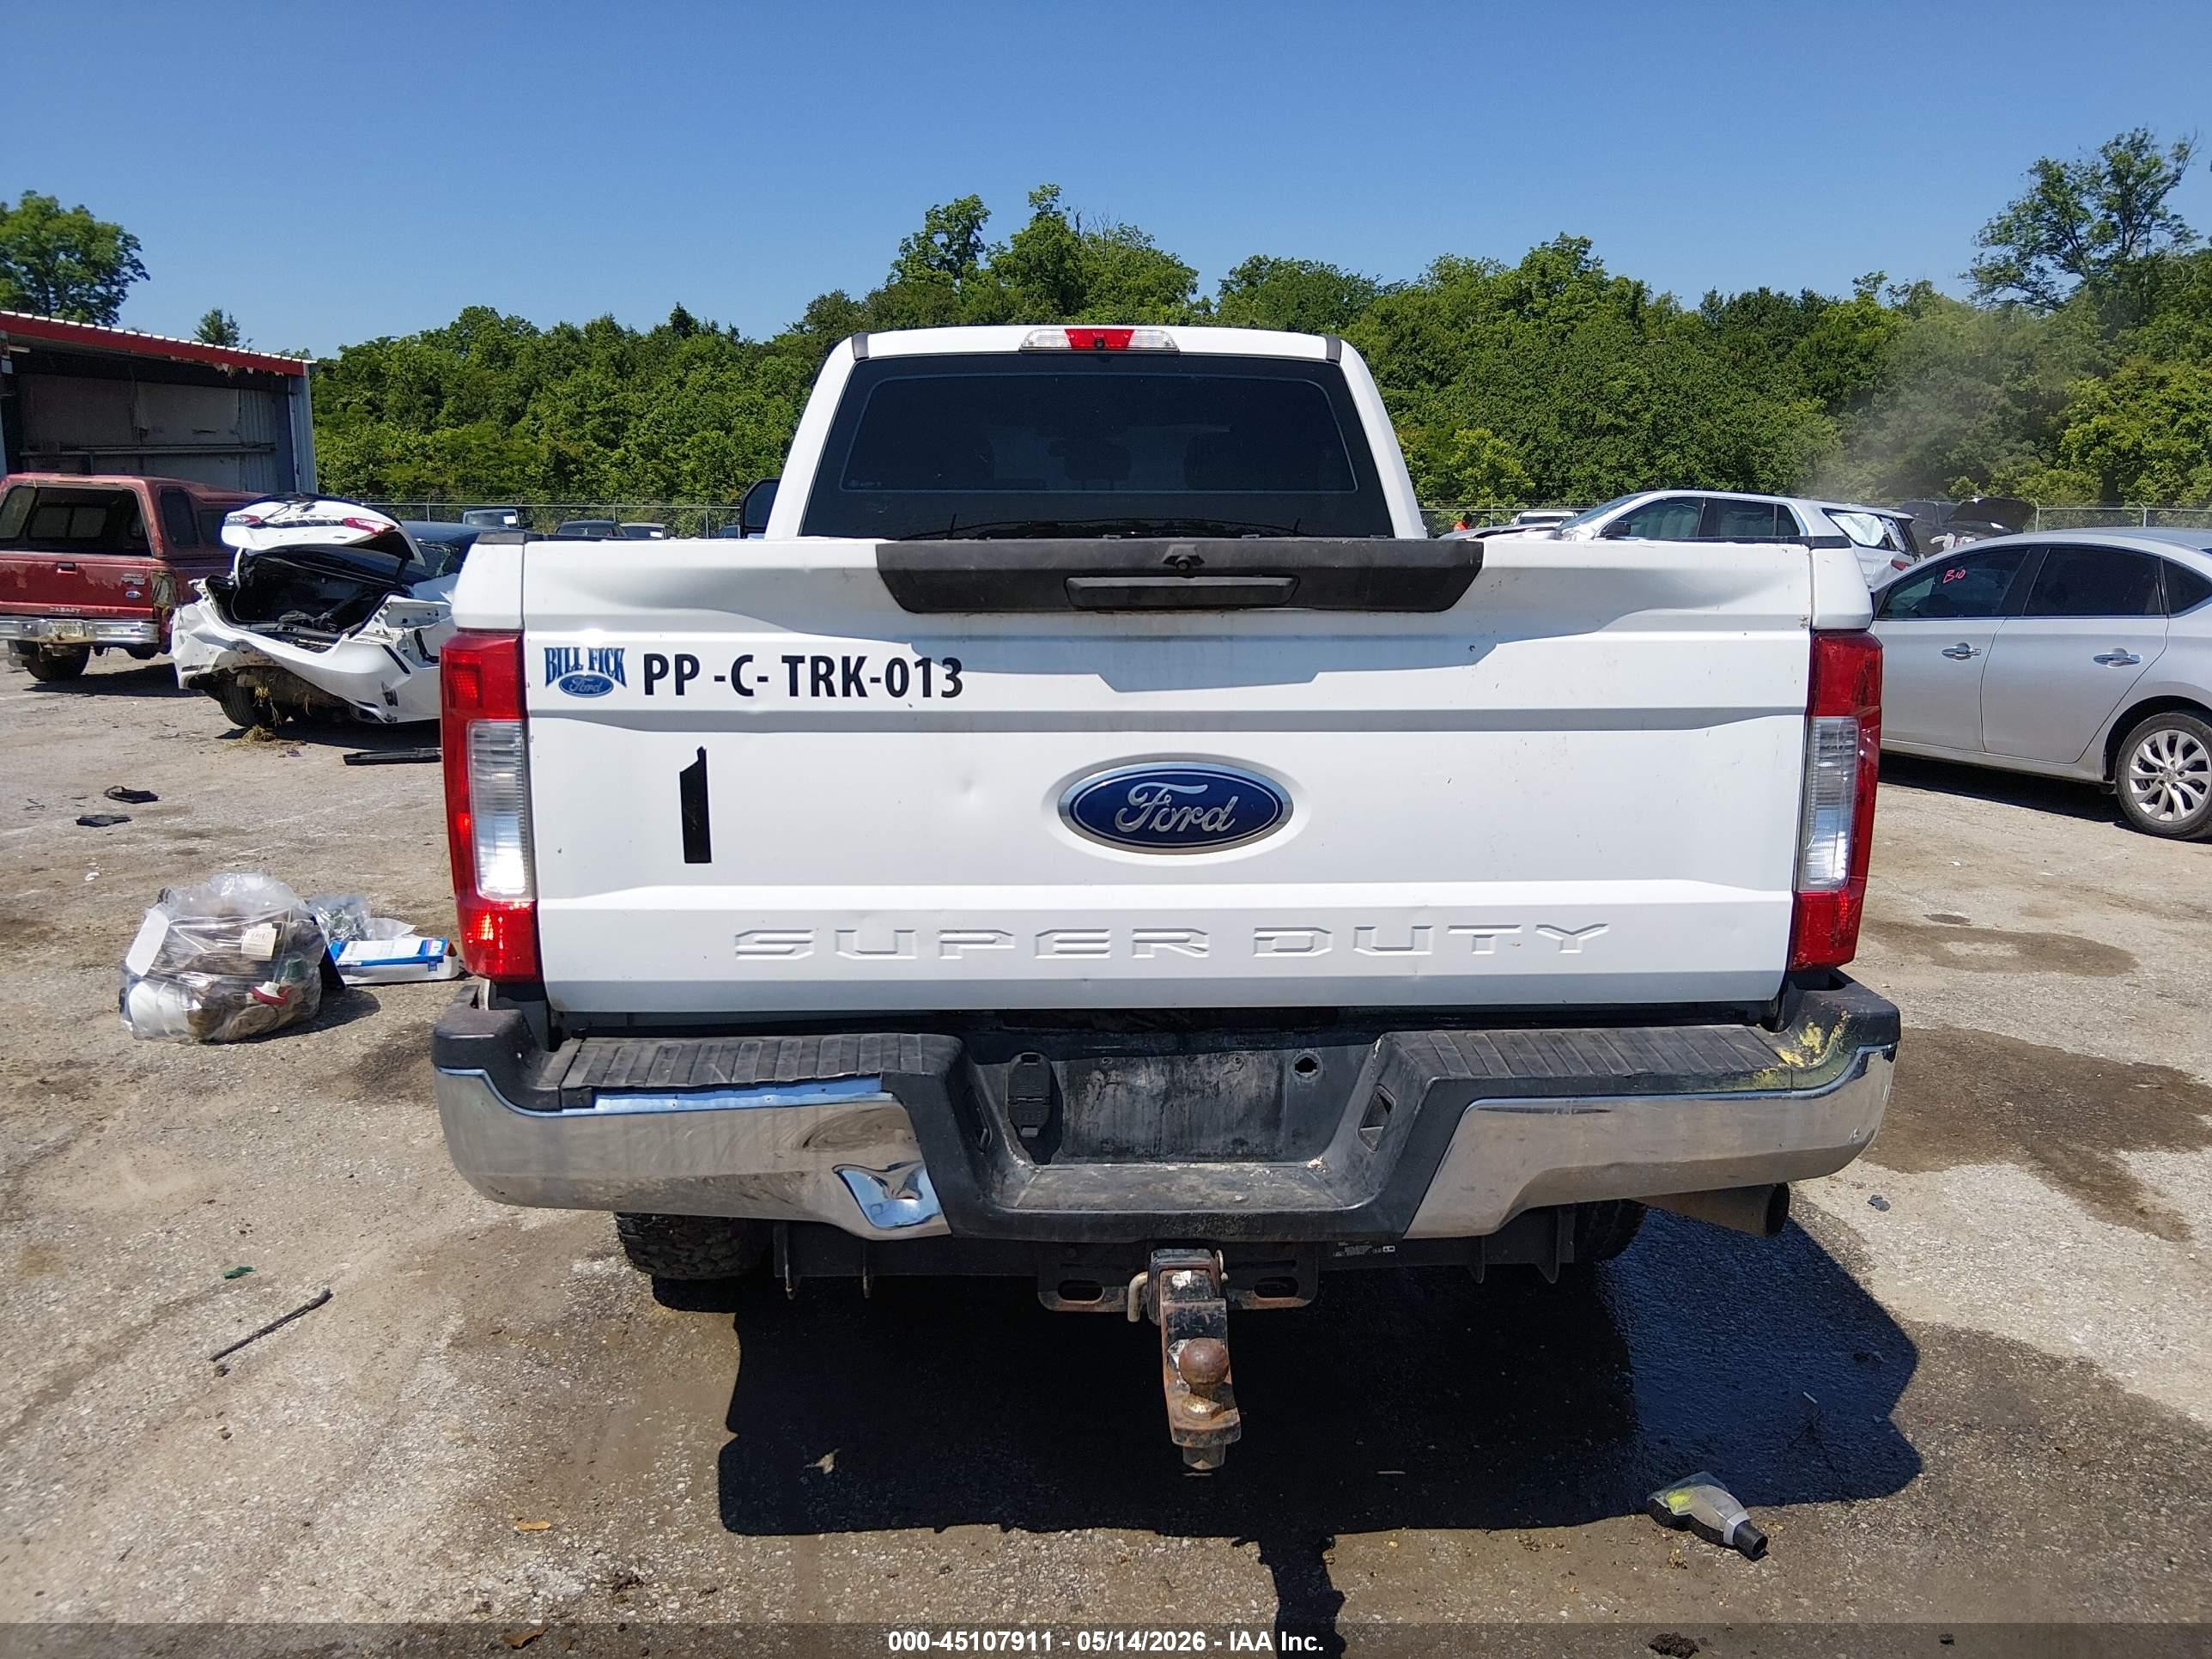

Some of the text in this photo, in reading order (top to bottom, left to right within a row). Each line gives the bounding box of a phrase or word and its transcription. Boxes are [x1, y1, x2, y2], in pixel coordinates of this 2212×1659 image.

[544, 647, 627, 688] BILL FICK
[568, 678, 604, 693] Ford
[643, 653, 701, 696] PP
[781, 655, 963, 698] TRK-013
[1114, 781, 1239, 833] Ford
[734, 923, 1610, 960] SUPER DUTY
